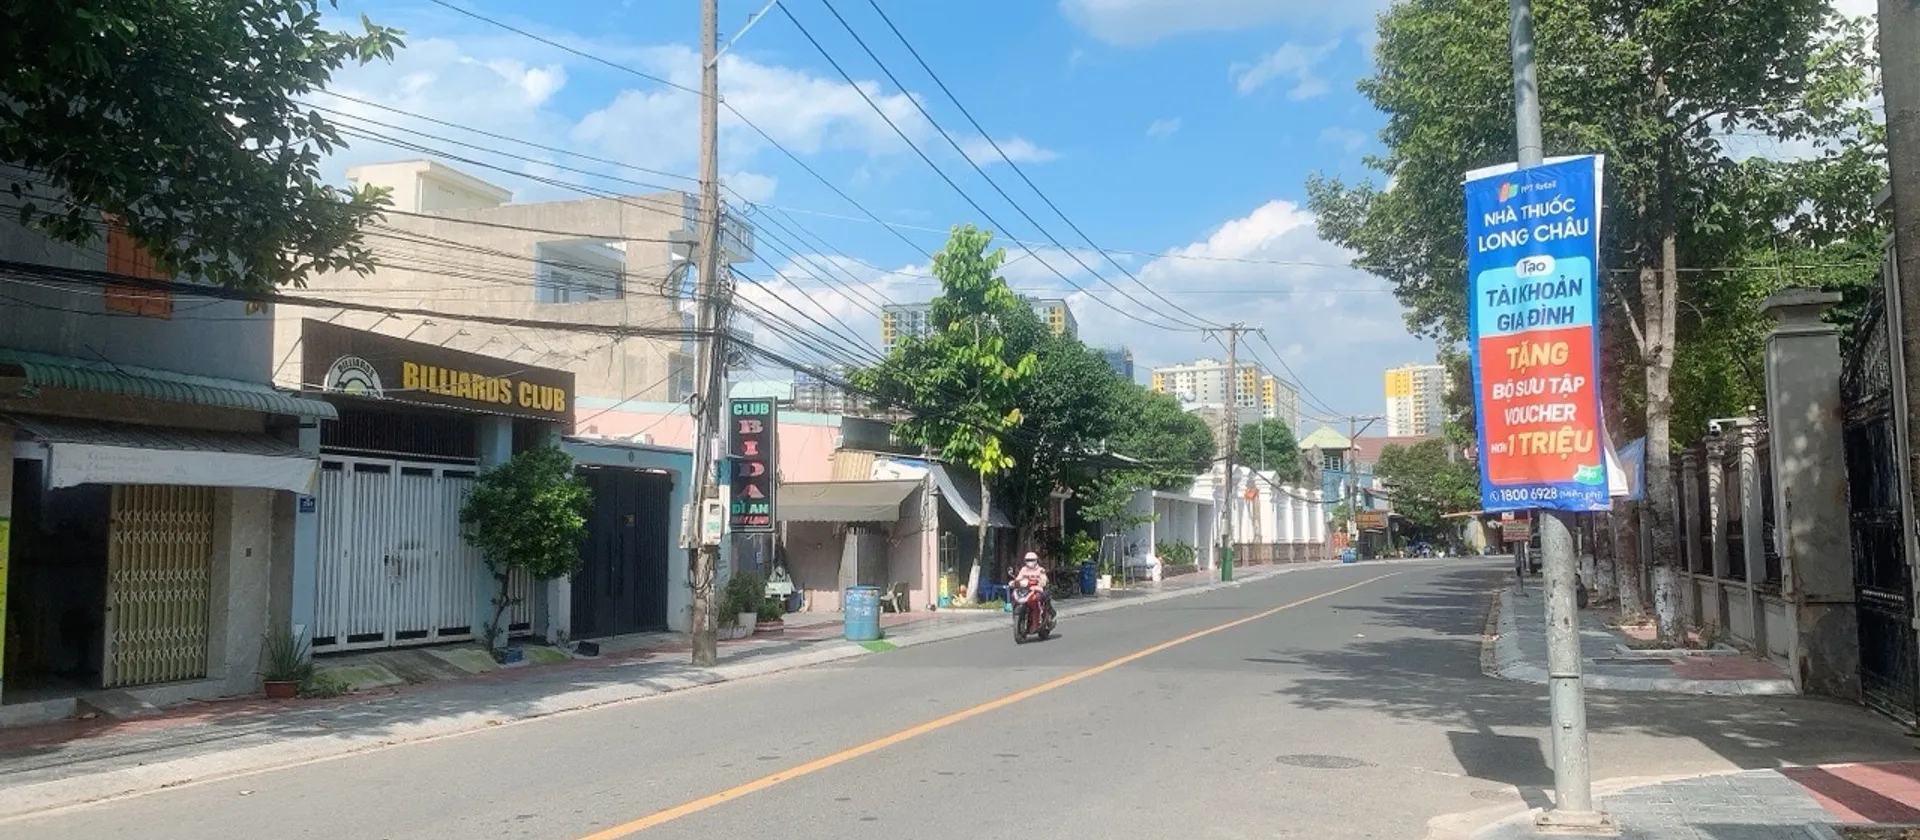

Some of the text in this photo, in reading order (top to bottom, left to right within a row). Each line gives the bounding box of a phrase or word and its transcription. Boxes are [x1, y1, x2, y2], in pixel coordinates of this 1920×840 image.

[1484, 194, 1576, 227] NHÀ THUỐC
[1479, 217, 1589, 253] LONG CHÂU
[1522, 260, 1546, 275] Tạo
[1486, 275, 1583, 307] TÀI KHOẢN
[1497, 304, 1575, 332] GIA ĐÌNH
[1506, 340, 1569, 374] TẶNG
[403, 361, 566, 413] BILLIARDS CLUB
[1492, 373, 1585, 402] BỘ SƯU TẬP
[733, 403, 769, 415] CLUB
[1504, 403, 1577, 426] VOUCHER
[1507, 434, 1516, 457] 1
[1518, 426, 1594, 460] TRIỆU
[750, 503, 769, 514] AN
[1501, 489, 1528, 502] 1800
[1530, 487, 1558, 500] 6928
